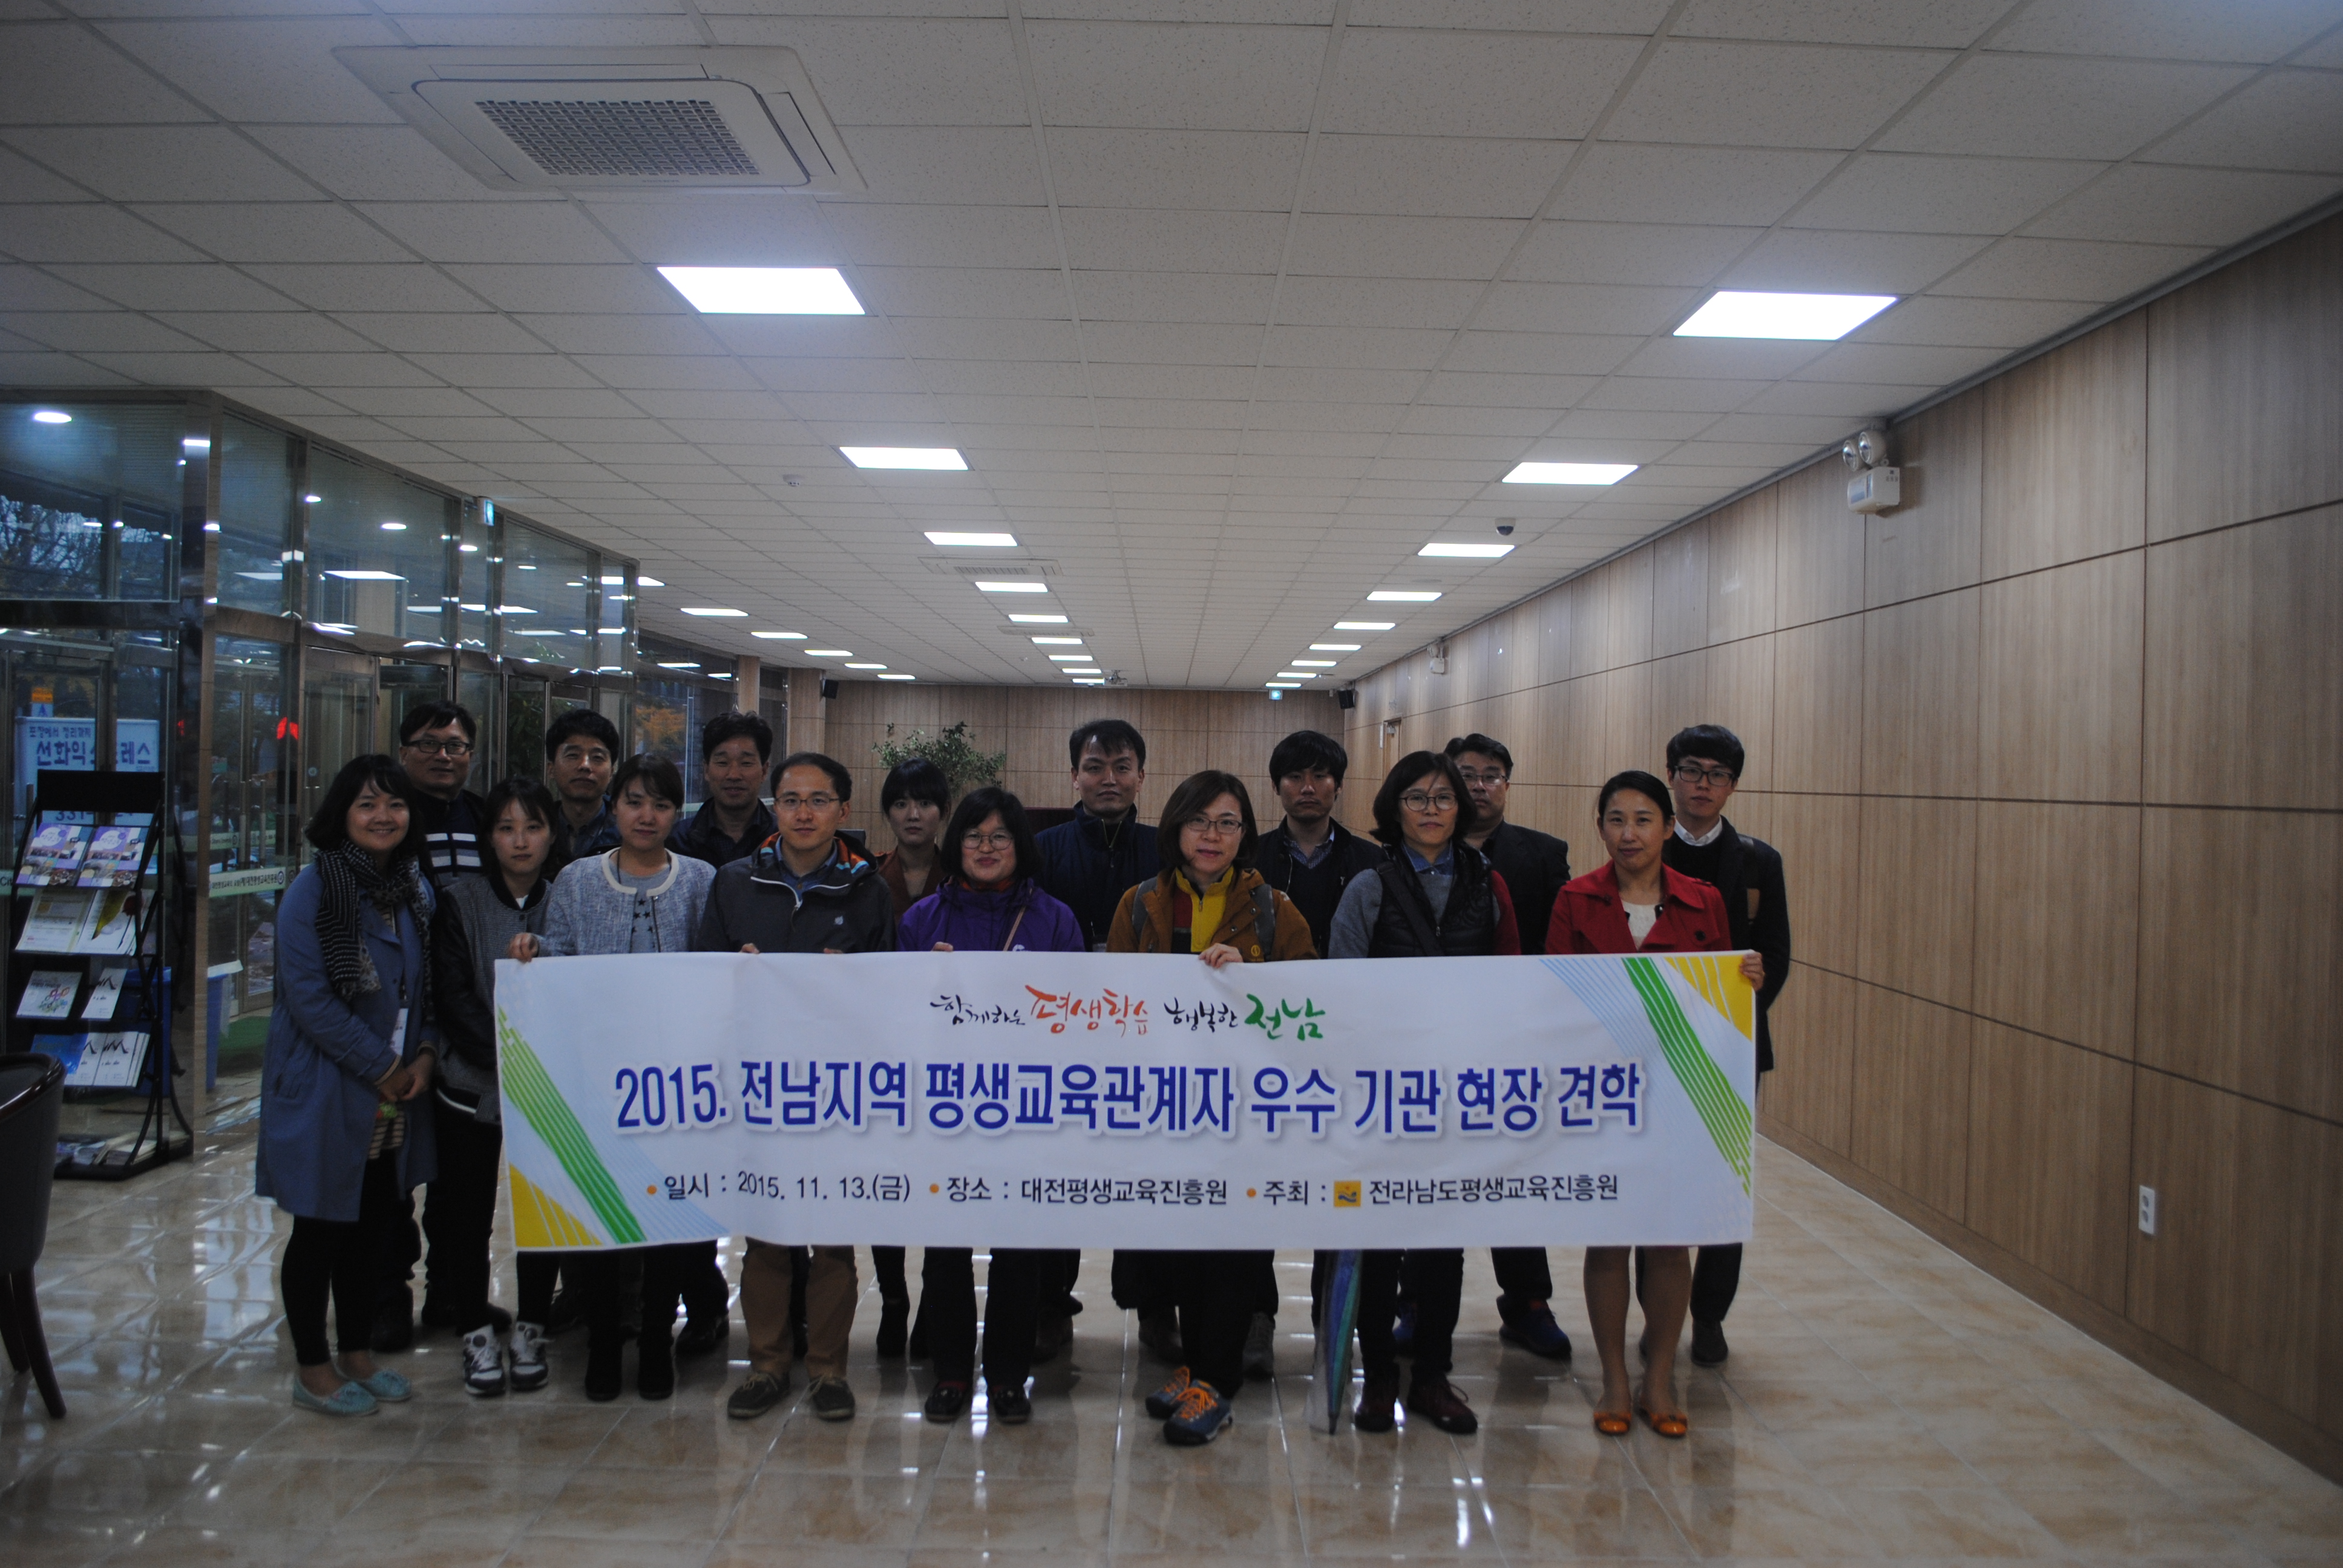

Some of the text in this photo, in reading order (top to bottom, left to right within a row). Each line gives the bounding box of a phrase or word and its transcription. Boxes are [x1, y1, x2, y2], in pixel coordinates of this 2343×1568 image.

[37, 740, 150, 766] 선화익레스
[929, 985, 1326, 1041] 함께하는 평생학습 행복한 전남
[615, 1061, 1640, 1134] 2015. 전남지역 평생교육관계자 우수 기관 현장 견학
[664, 1173, 709, 1200] 일시
[738, 1171, 785, 1200] 2015.
[797, 1177, 827, 1200] 11.
[840, 1174, 910, 1202] 13.(금)
[947, 1177, 992, 1202] 장소
[1021, 1178, 1227, 1205] 대전평생교육진흥원
[1263, 1181, 1308, 1206] 주최
[1369, 1175, 1617, 1204] 전라남도평생교육진흥원
